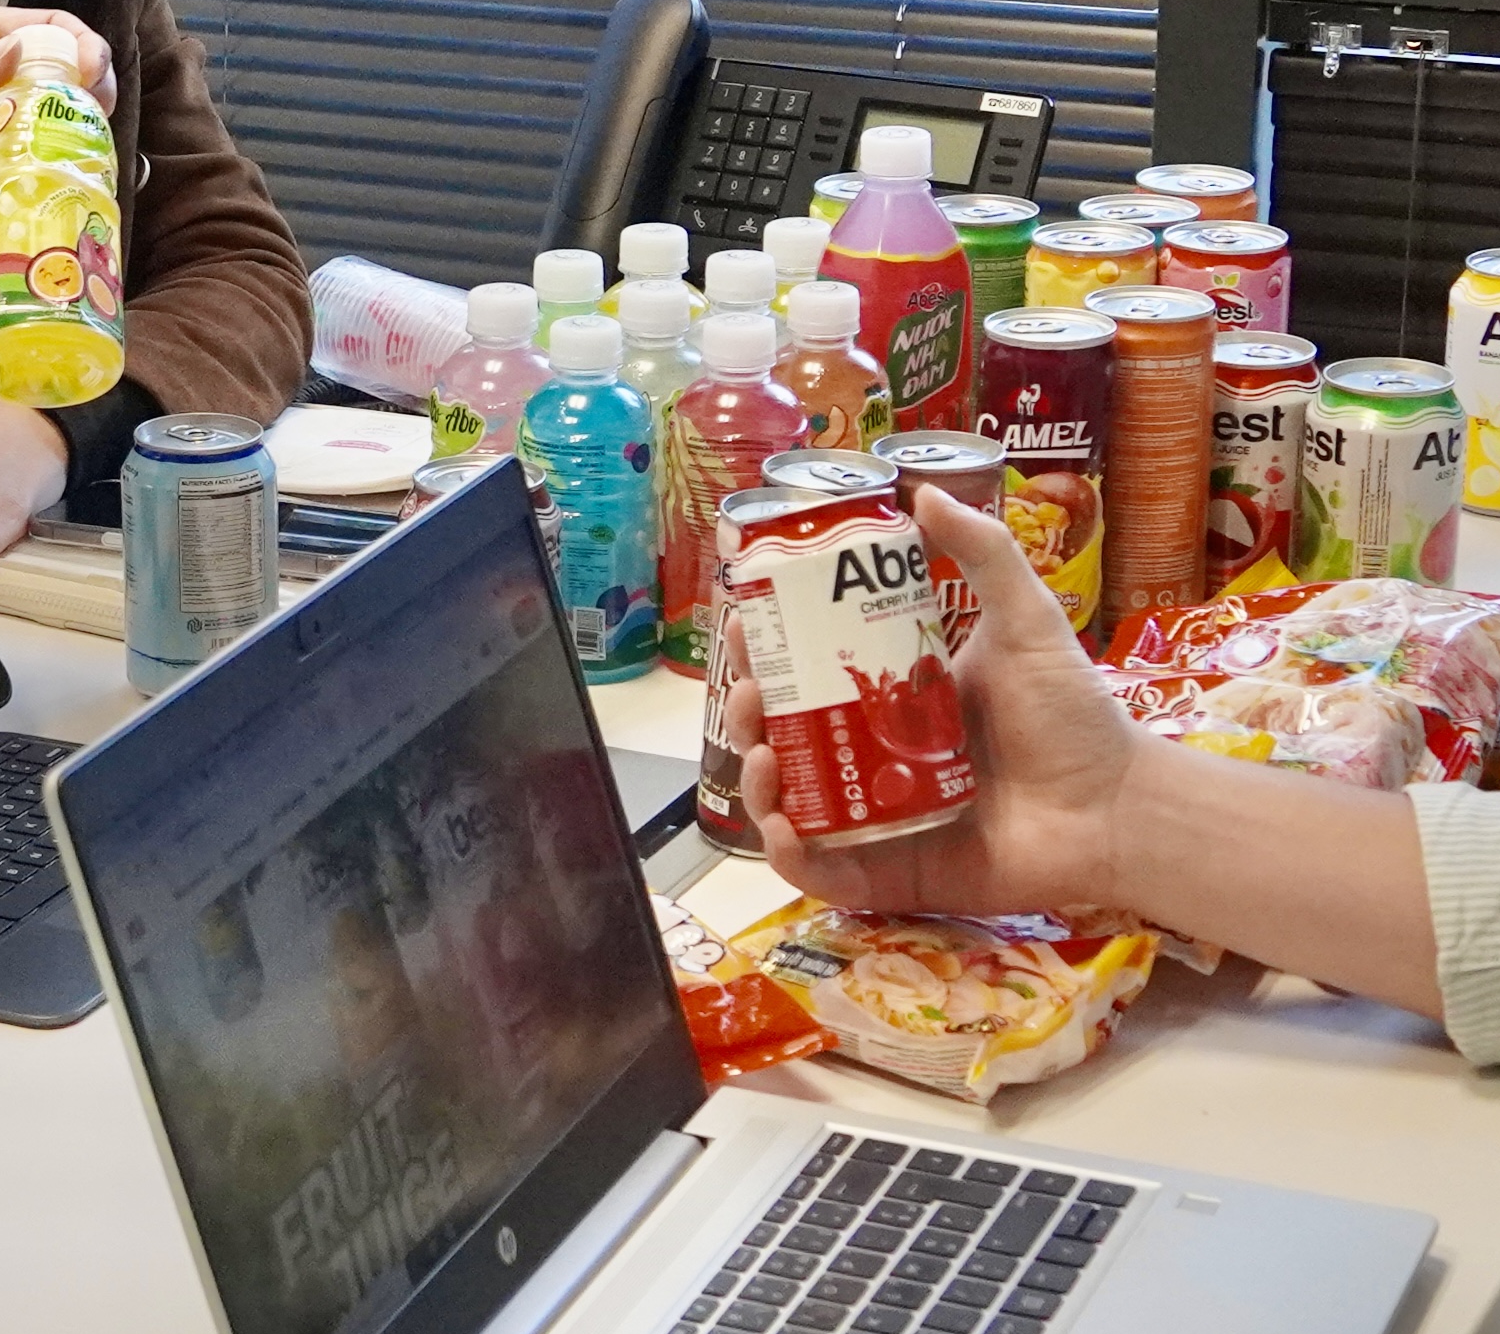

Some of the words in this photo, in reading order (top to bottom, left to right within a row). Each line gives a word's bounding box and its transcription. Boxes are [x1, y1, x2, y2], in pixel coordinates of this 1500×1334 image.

[37, 96, 76, 122] Abo
[861, 591, 910, 614] CHERRY
[1111, 678, 1164, 710] alo
[940, 777, 965, 799] 330
